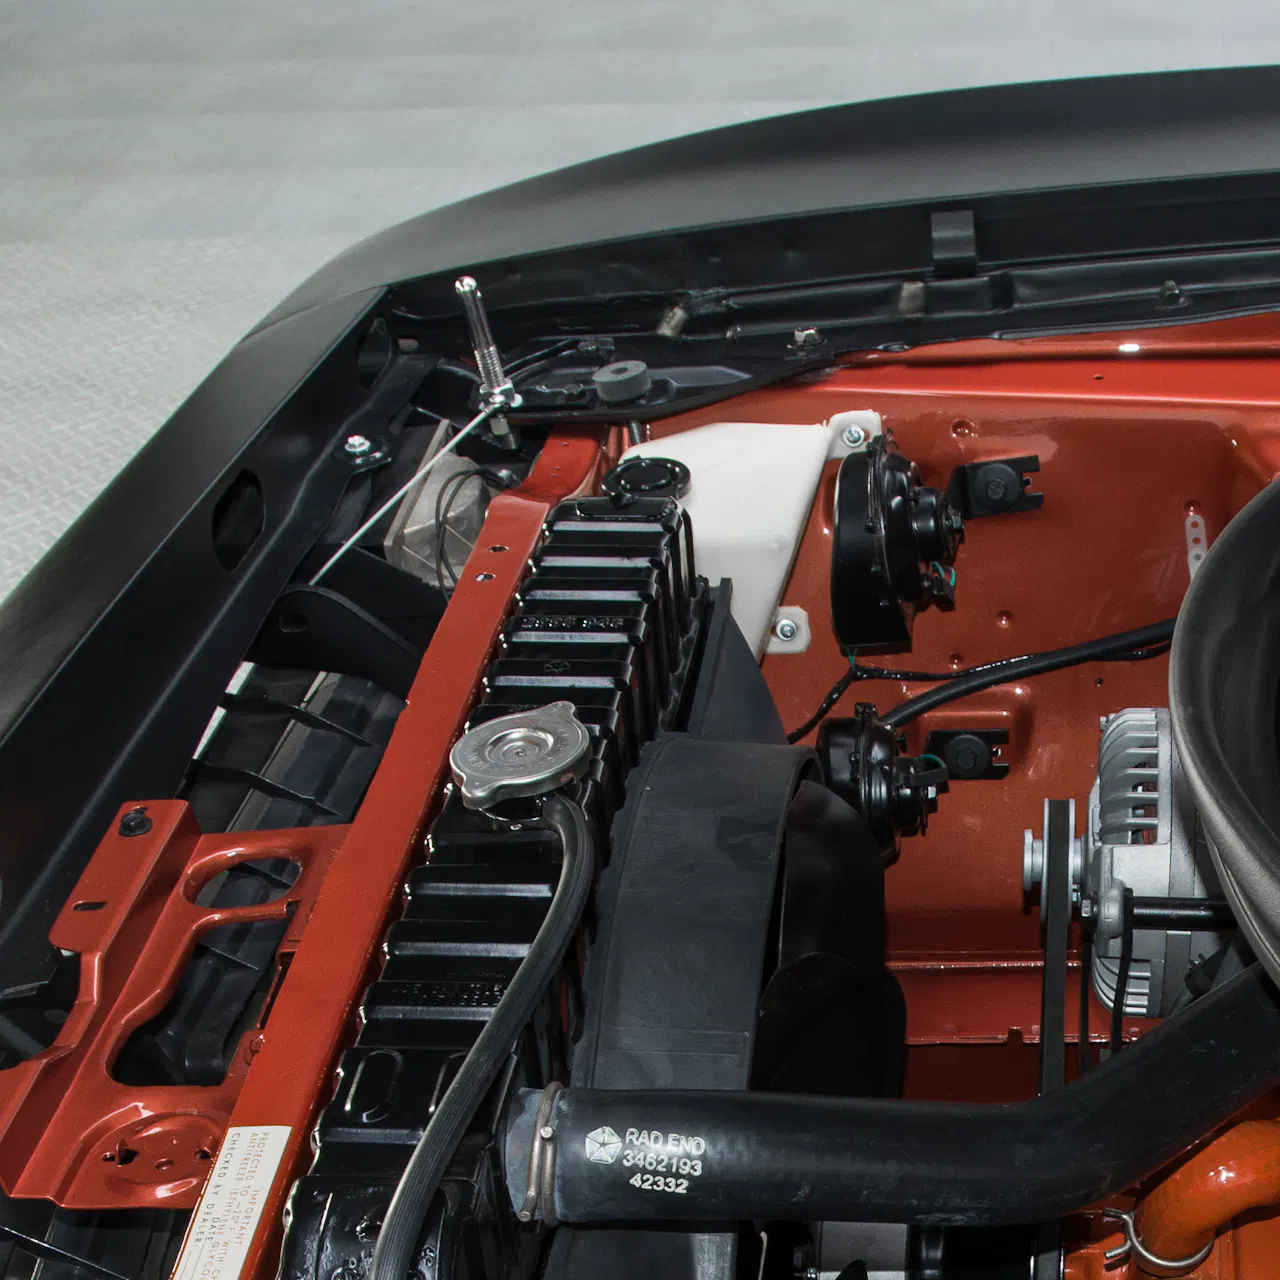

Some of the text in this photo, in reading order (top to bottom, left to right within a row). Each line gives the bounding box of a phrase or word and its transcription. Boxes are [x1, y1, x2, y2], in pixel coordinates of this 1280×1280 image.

[244, 1131, 270, 1181] PROTECTED
[626, 1128, 706, 1156] RAD END
[233, 1131, 260, 1182] ANTIFREEZE
[622, 1149, 703, 1177] 3462193
[191, 1131, 241, 1247] CHECKED BY DEALER:
[238, 1184, 251, 1197] TO
[629, 1172, 689, 1194] 42332
[203, 1216, 221, 1241] DATE
[232, 1188, 261, 1245] IMPORTANT
[214, 1239, 232, 1263] WITH
